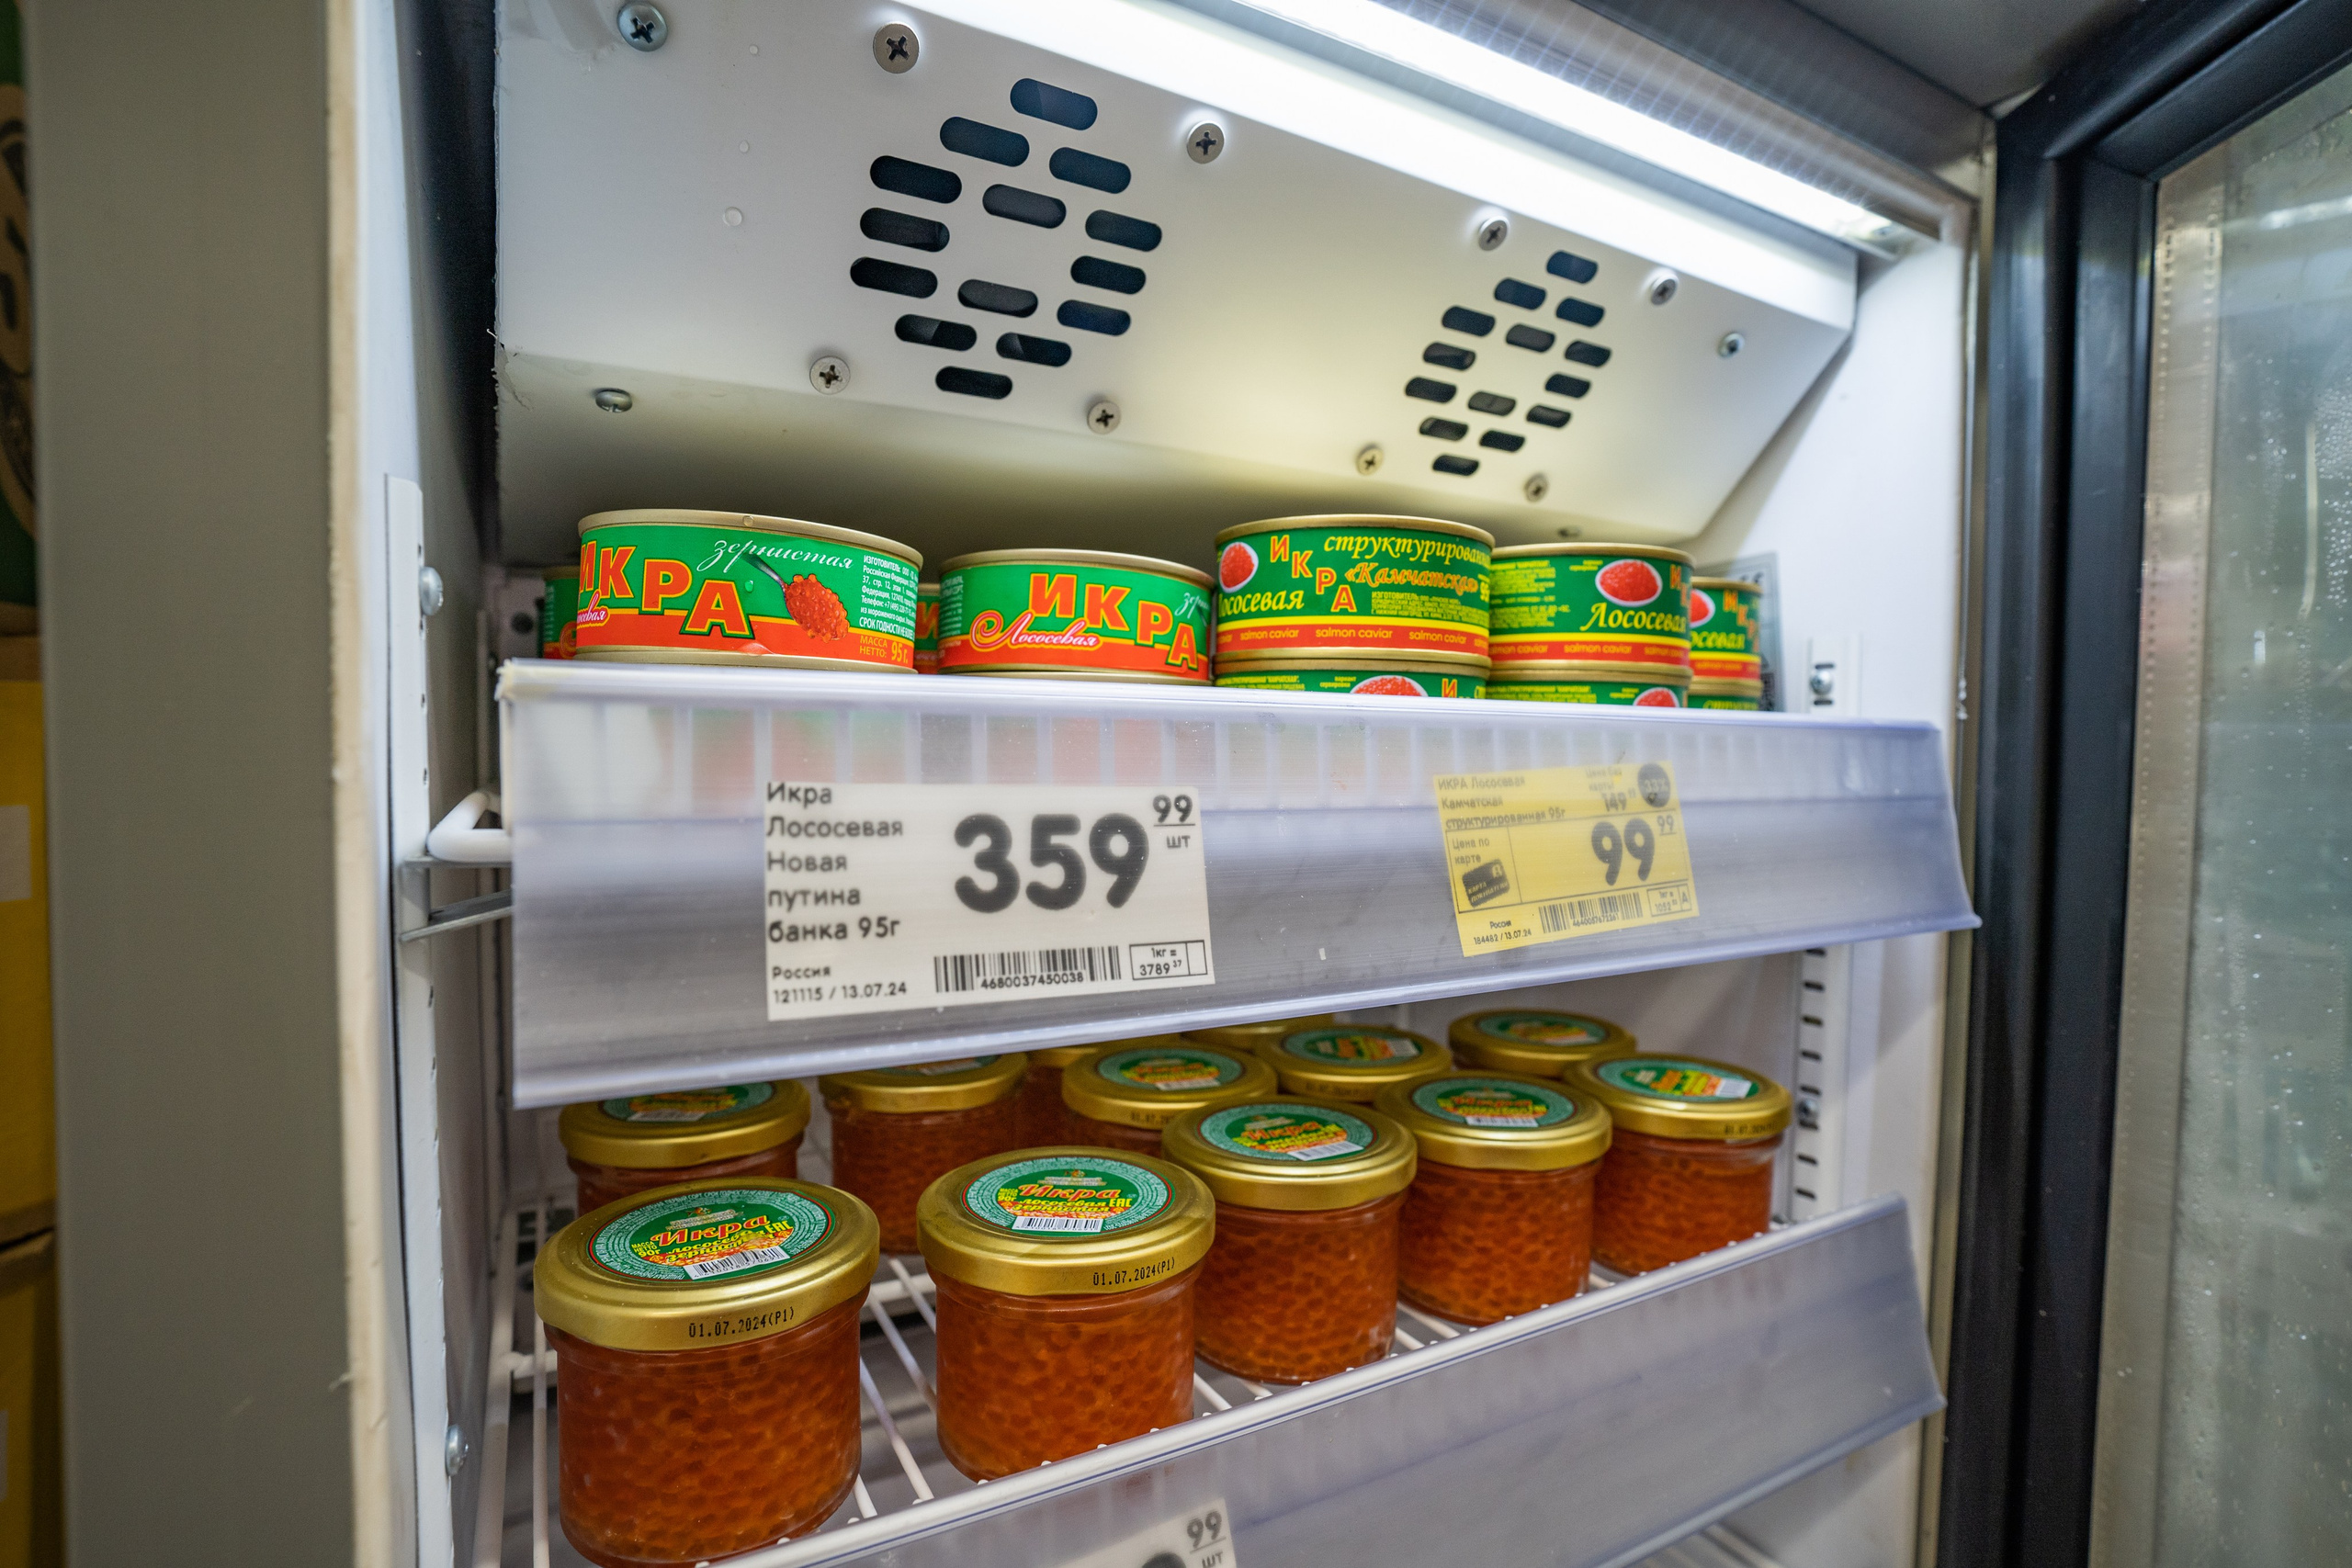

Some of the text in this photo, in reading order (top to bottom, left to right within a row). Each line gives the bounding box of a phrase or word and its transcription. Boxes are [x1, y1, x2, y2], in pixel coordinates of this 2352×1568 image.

[696, 540, 854, 573] зернистая
[863, 575, 871, 585] 37,
[873, 579, 883, 588] стр.
[1270, 534, 1357, 613] ИКРА
[859, 616, 876, 629] СРОК
[971, 610, 1100, 649] Лососевая
[1030, 572, 1198, 671] ИКРА
[1269, 627, 1300, 639] caviar
[1316, 627, 1393, 639] salmon caviar
[1408, 630, 1442, 642] salmon
[860, 635, 888, 648] МАССА
[891, 641, 903, 662] 95
[903, 649, 909, 664] г.
[860, 645, 888, 658] НЕТТО:
[1564, 643, 1633, 654] salmon caviar
[1438, 778, 1468, 791] ИКРА
[766, 782, 832, 807] Икра
[1442, 796, 1504, 809] Камчатская
[1600, 792, 1627, 812] 149
[765, 815, 904, 837] Лососевая
[1445, 806, 1566, 830] структурированная 95г
[1166, 833, 1192, 850] шт
[1453, 838, 1490, 852] Цена по
[1590, 814, 1675, 886] 99 99
[766, 852, 848, 872] Новая
[953, 794, 1193, 914] 359 99
[1454, 853, 1481, 866] карте
[768, 888, 861, 910] путина
[768, 917, 900, 942] банка 95г
[1489, 919, 1512, 930] Россия
[1504, 928, 1532, 941] 13.07.24
[1151, 947, 1167, 958] 1кг
[772, 965, 831, 980] Россия
[1139, 959, 1182, 976] 3789 37
[980, 971, 1084, 989] 4680037450038
[774, 987, 823, 1004] 121115
[841, 981, 908, 999] 13.07.24
[1018, 1184, 1122, 1202] Икра
[1012, 1204, 1110, 1213] зернистая
[1019, 1198, 1106, 1207] лососевая
[650, 1215, 771, 1247] Икра
[631, 1240, 655, 1248] МАССА
[638, 1249, 661, 1258] 90г
[1186, 1510, 1222, 1549] 99
